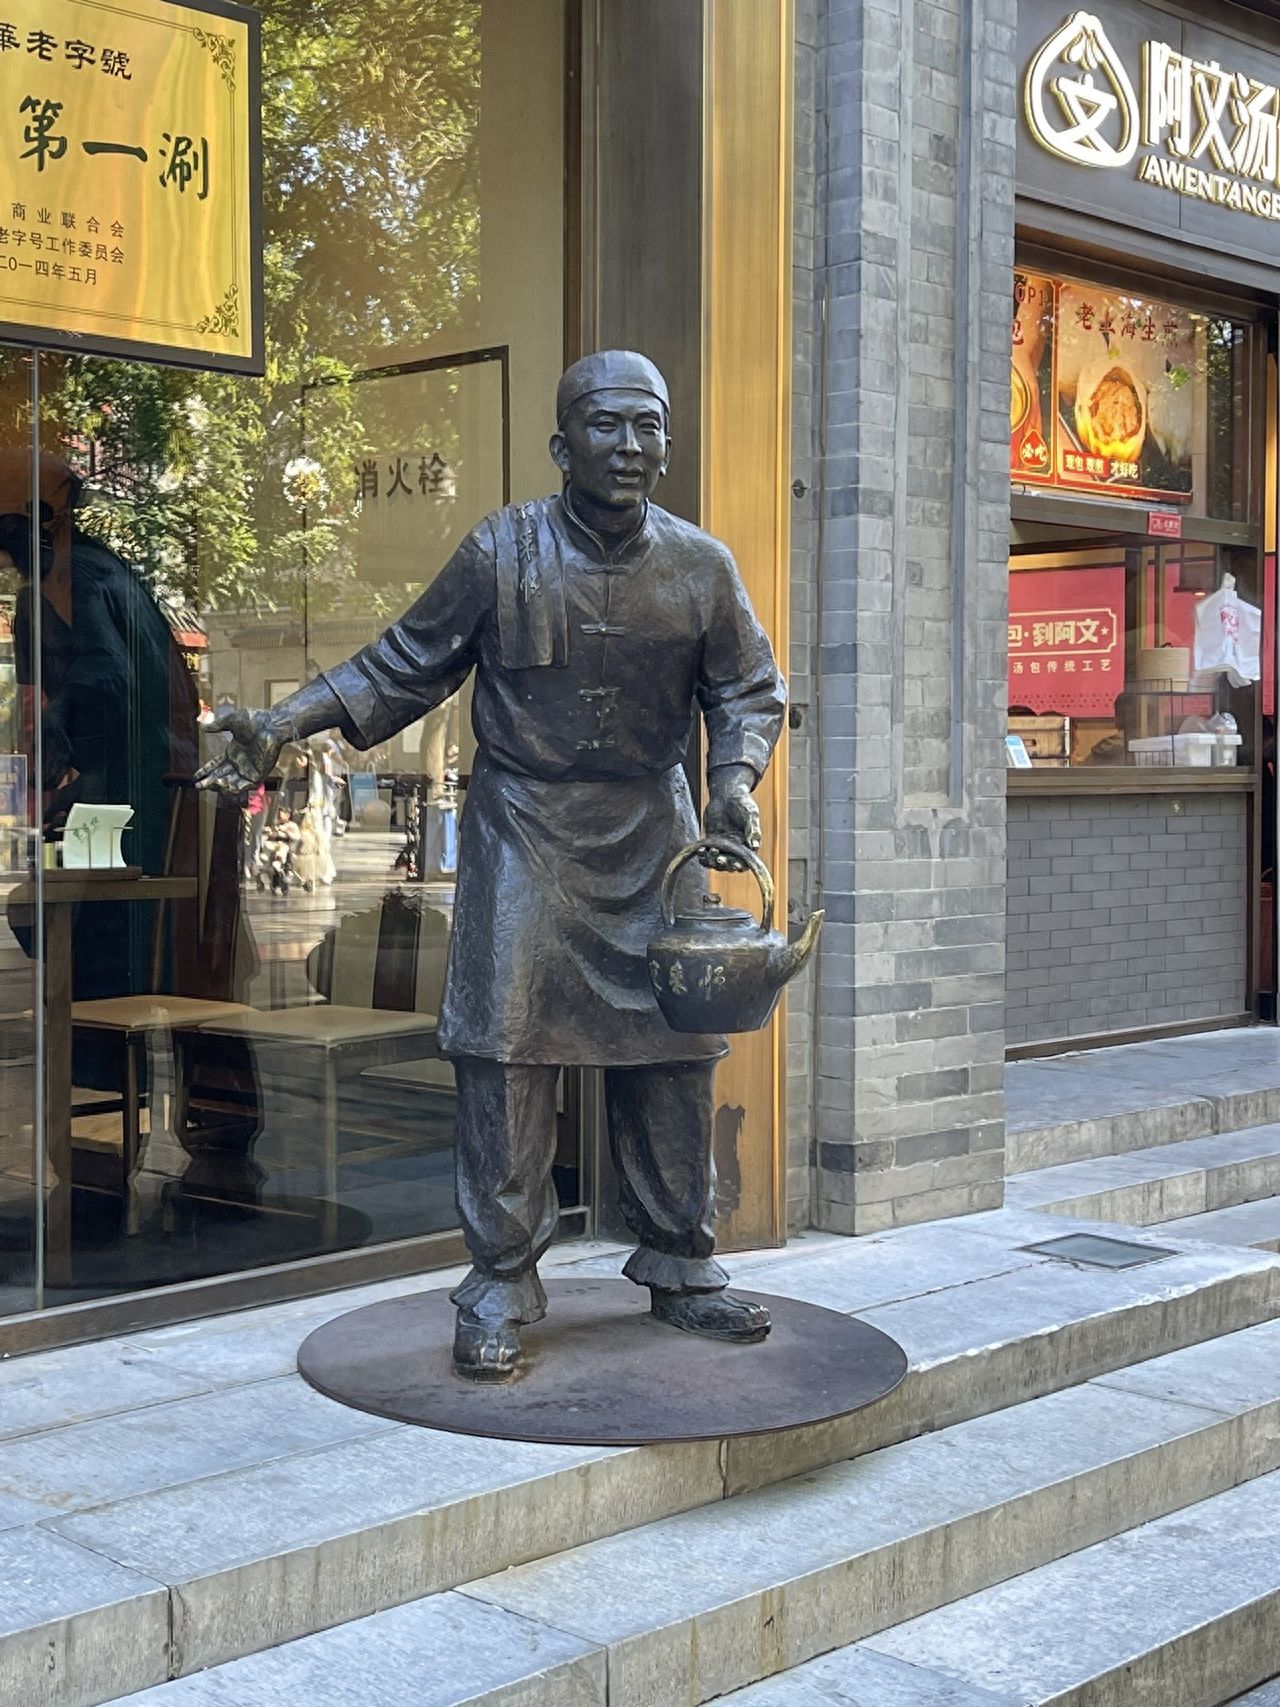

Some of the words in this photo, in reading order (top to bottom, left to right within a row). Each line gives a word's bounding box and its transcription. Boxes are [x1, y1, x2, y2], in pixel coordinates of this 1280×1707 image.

[1142, 40, 1280, 180] 阿文汤
[19, 95, 209, 200] 第一涮
[12, 202, 124, 239] 商业联合会
[0, 226, 124, 264] 老字号工作委员会
[354, 452, 447, 499] 消火栓
